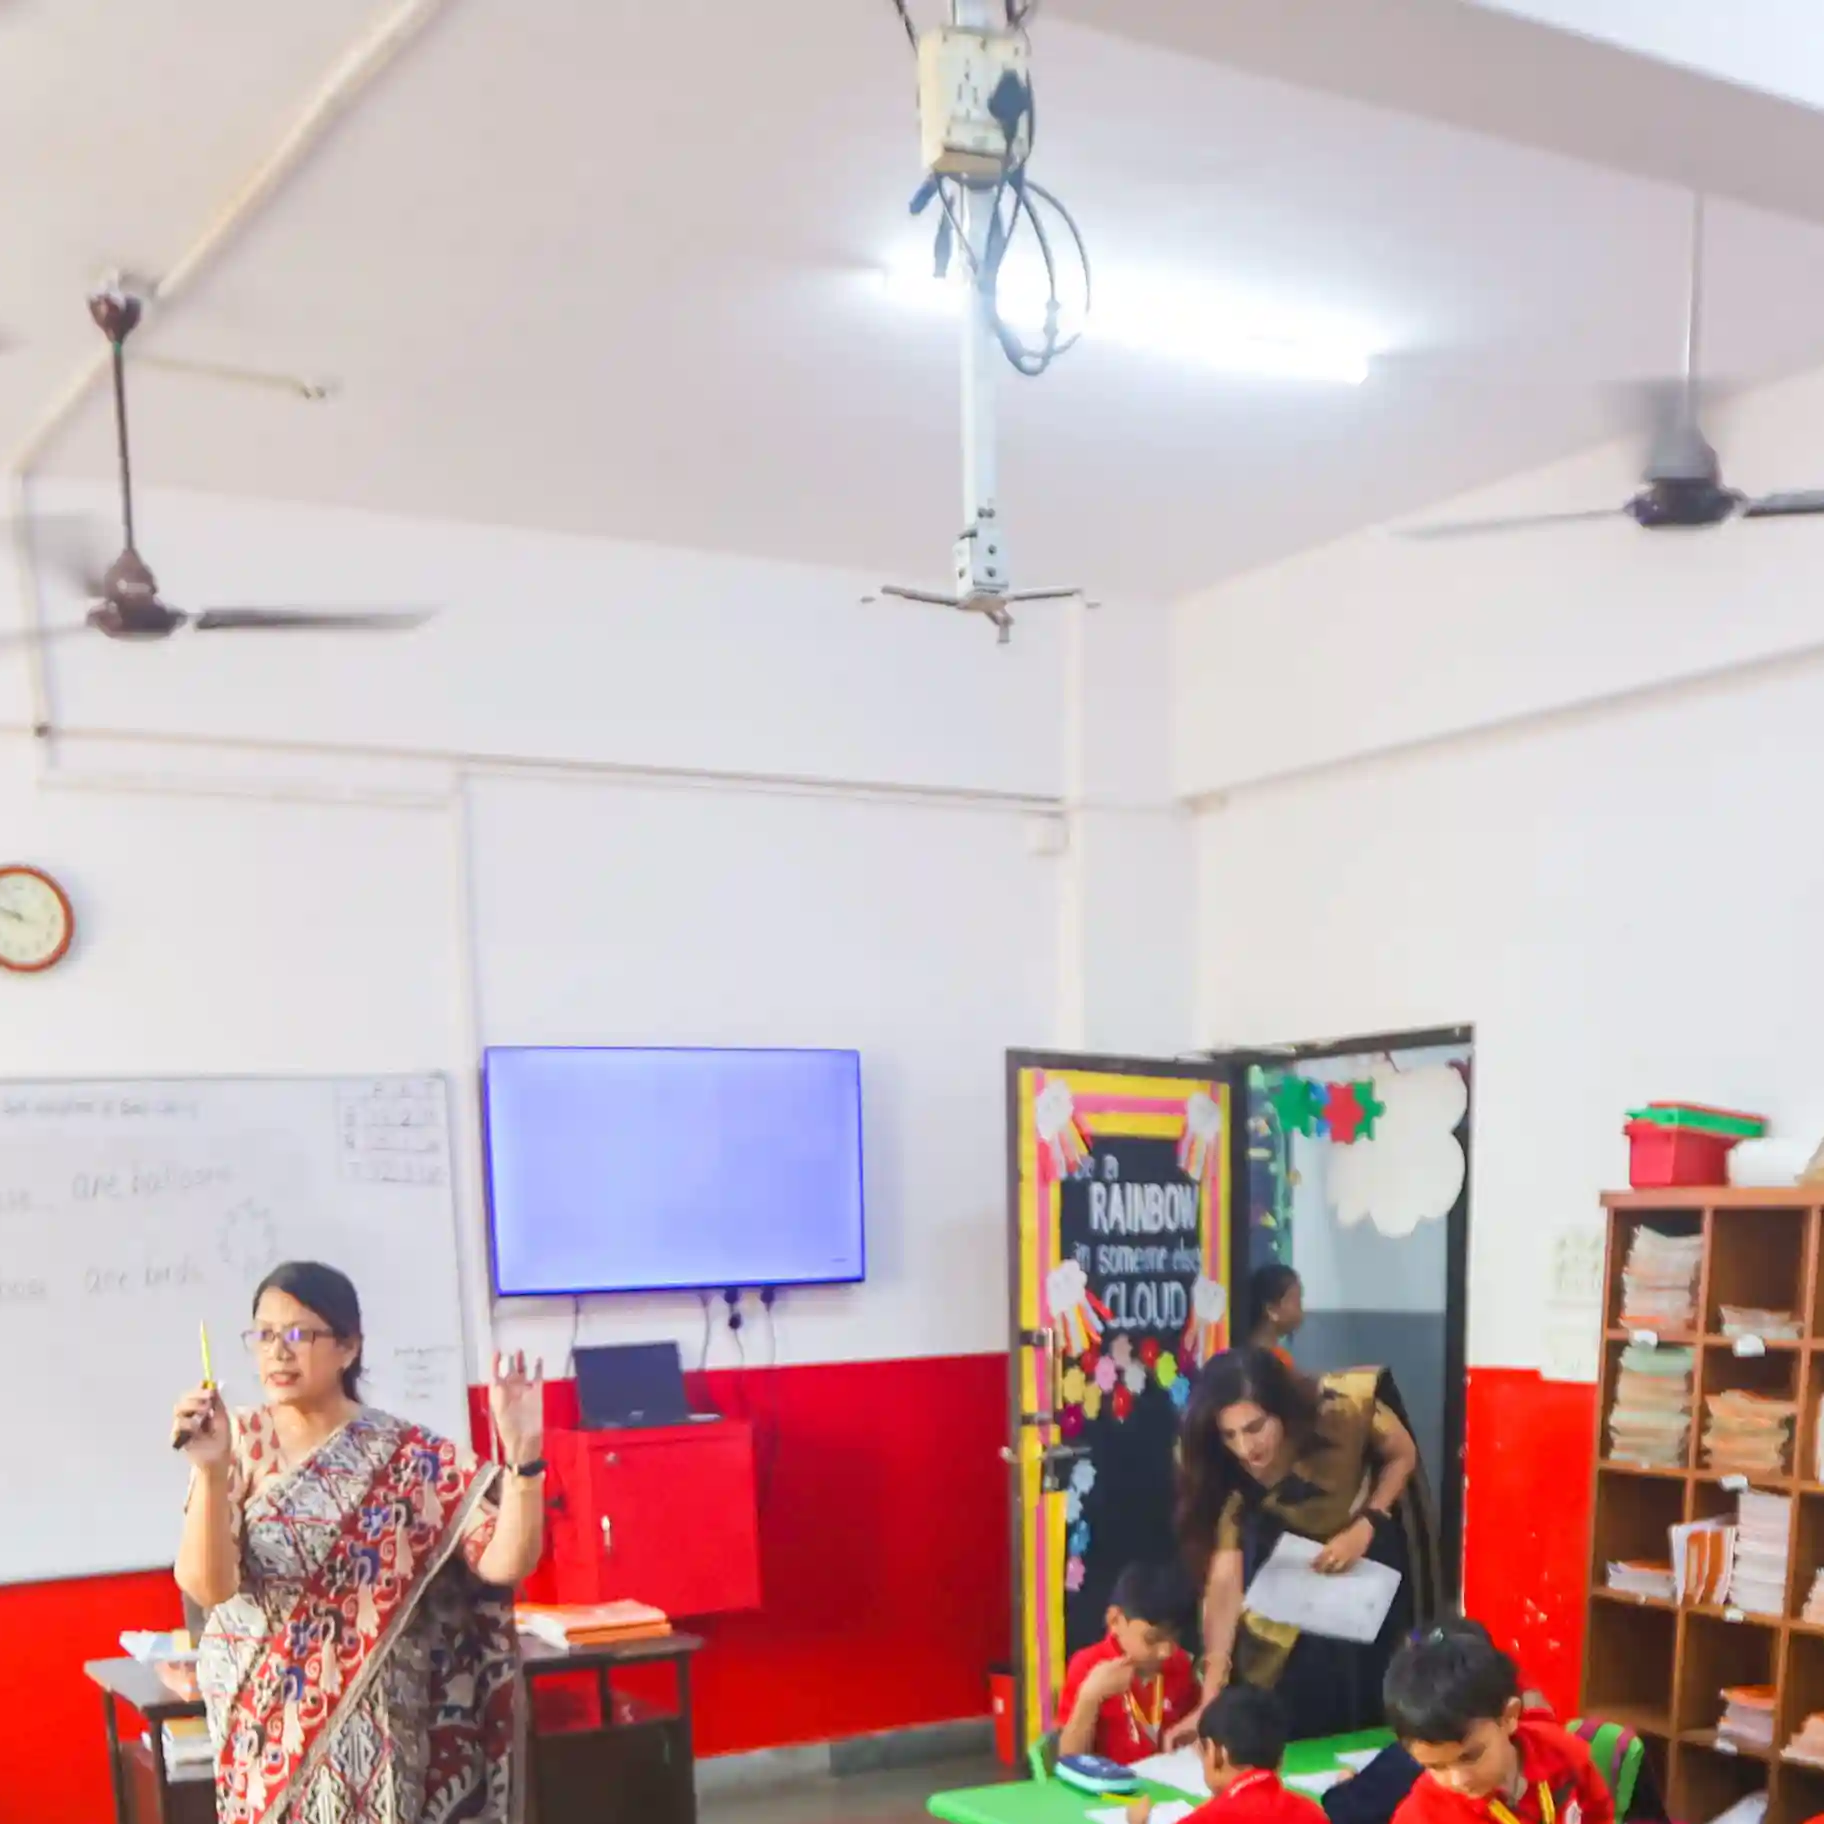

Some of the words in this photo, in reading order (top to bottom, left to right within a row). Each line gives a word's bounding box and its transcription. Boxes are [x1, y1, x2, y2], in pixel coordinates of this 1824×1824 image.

[72, 1171, 122, 1200] are
[1089, 1181, 1200, 1236] RAINBOW
[1097, 1244, 1167, 1275] someone
[84, 1264, 129, 1296] are
[1103, 1280, 1188, 1330] CLOUD
